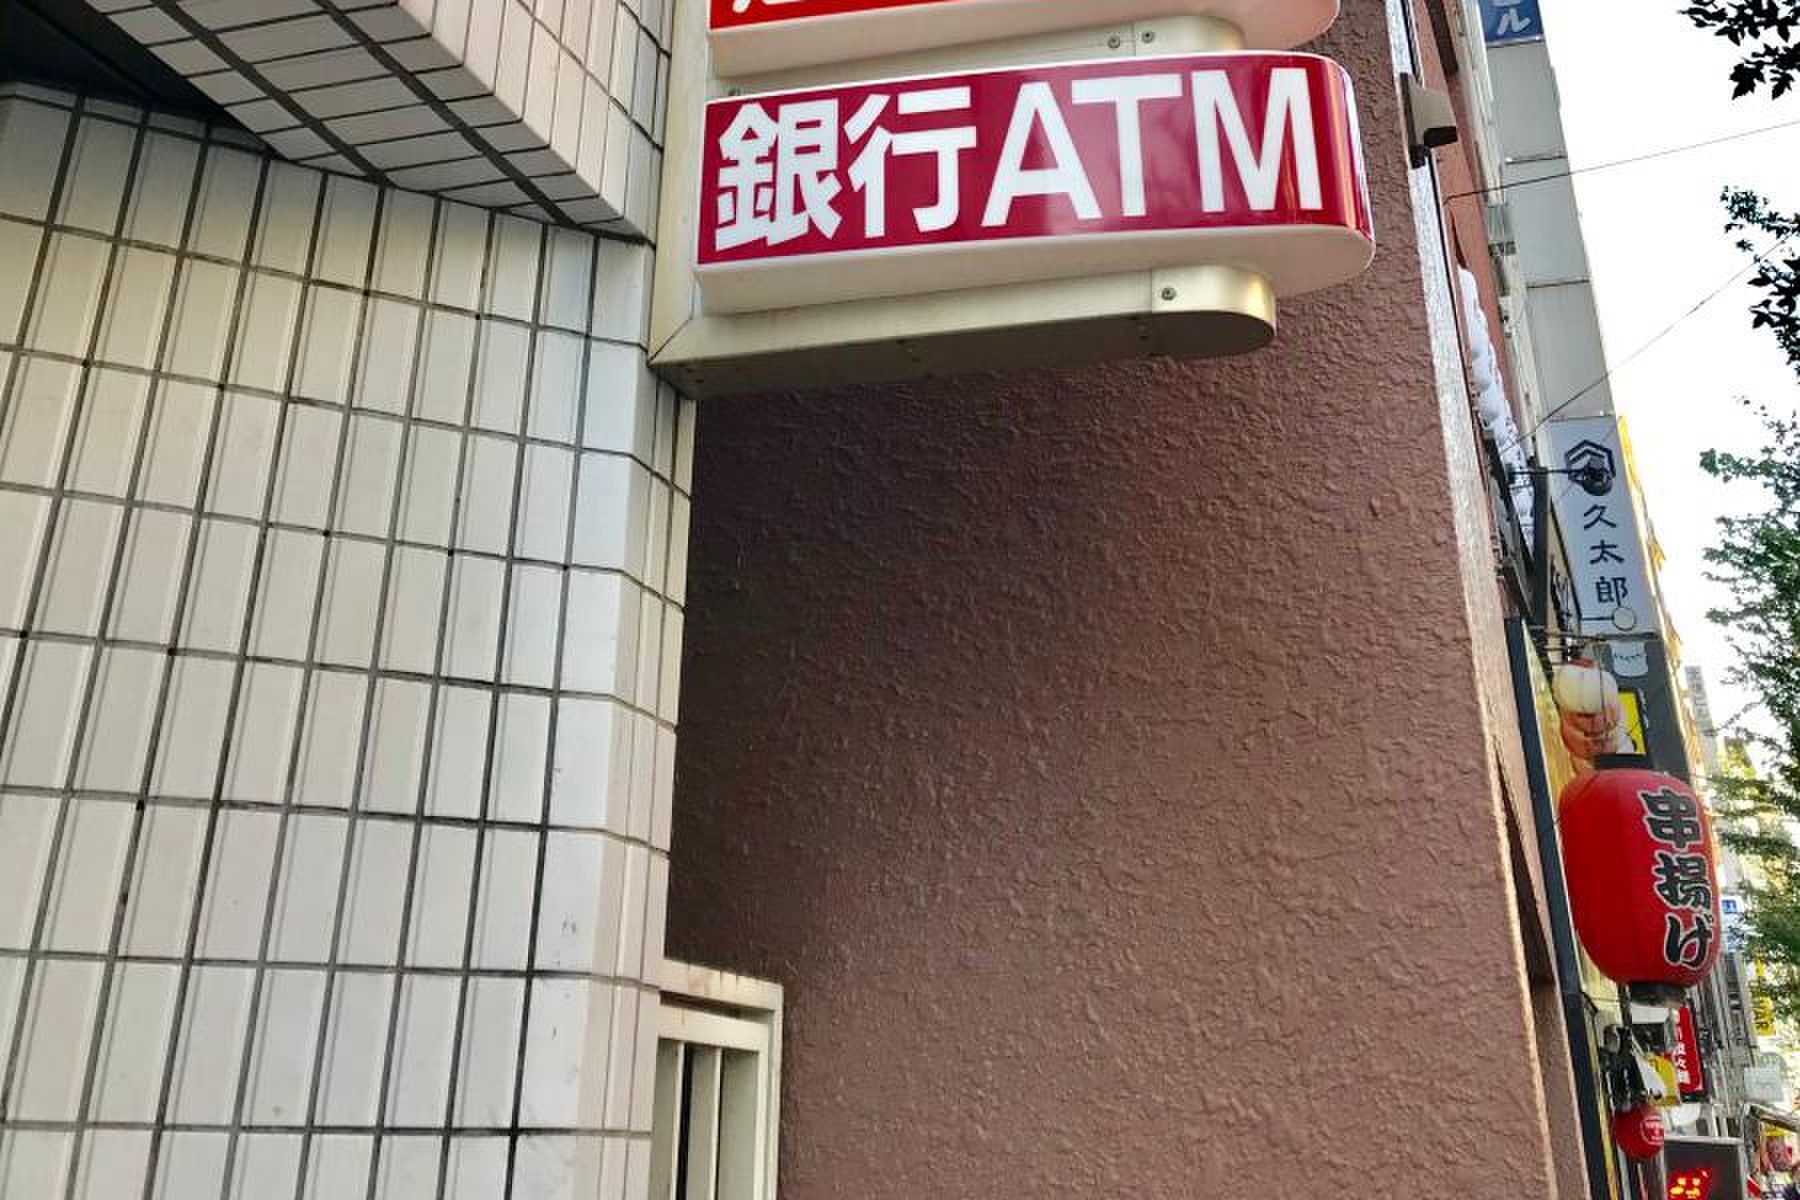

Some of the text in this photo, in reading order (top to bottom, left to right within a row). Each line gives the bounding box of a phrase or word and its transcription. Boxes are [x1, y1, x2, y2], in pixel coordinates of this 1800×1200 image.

[1583, 504, 1629, 607] 久太郎
[1638, 786, 1714, 970] 串揚げ
